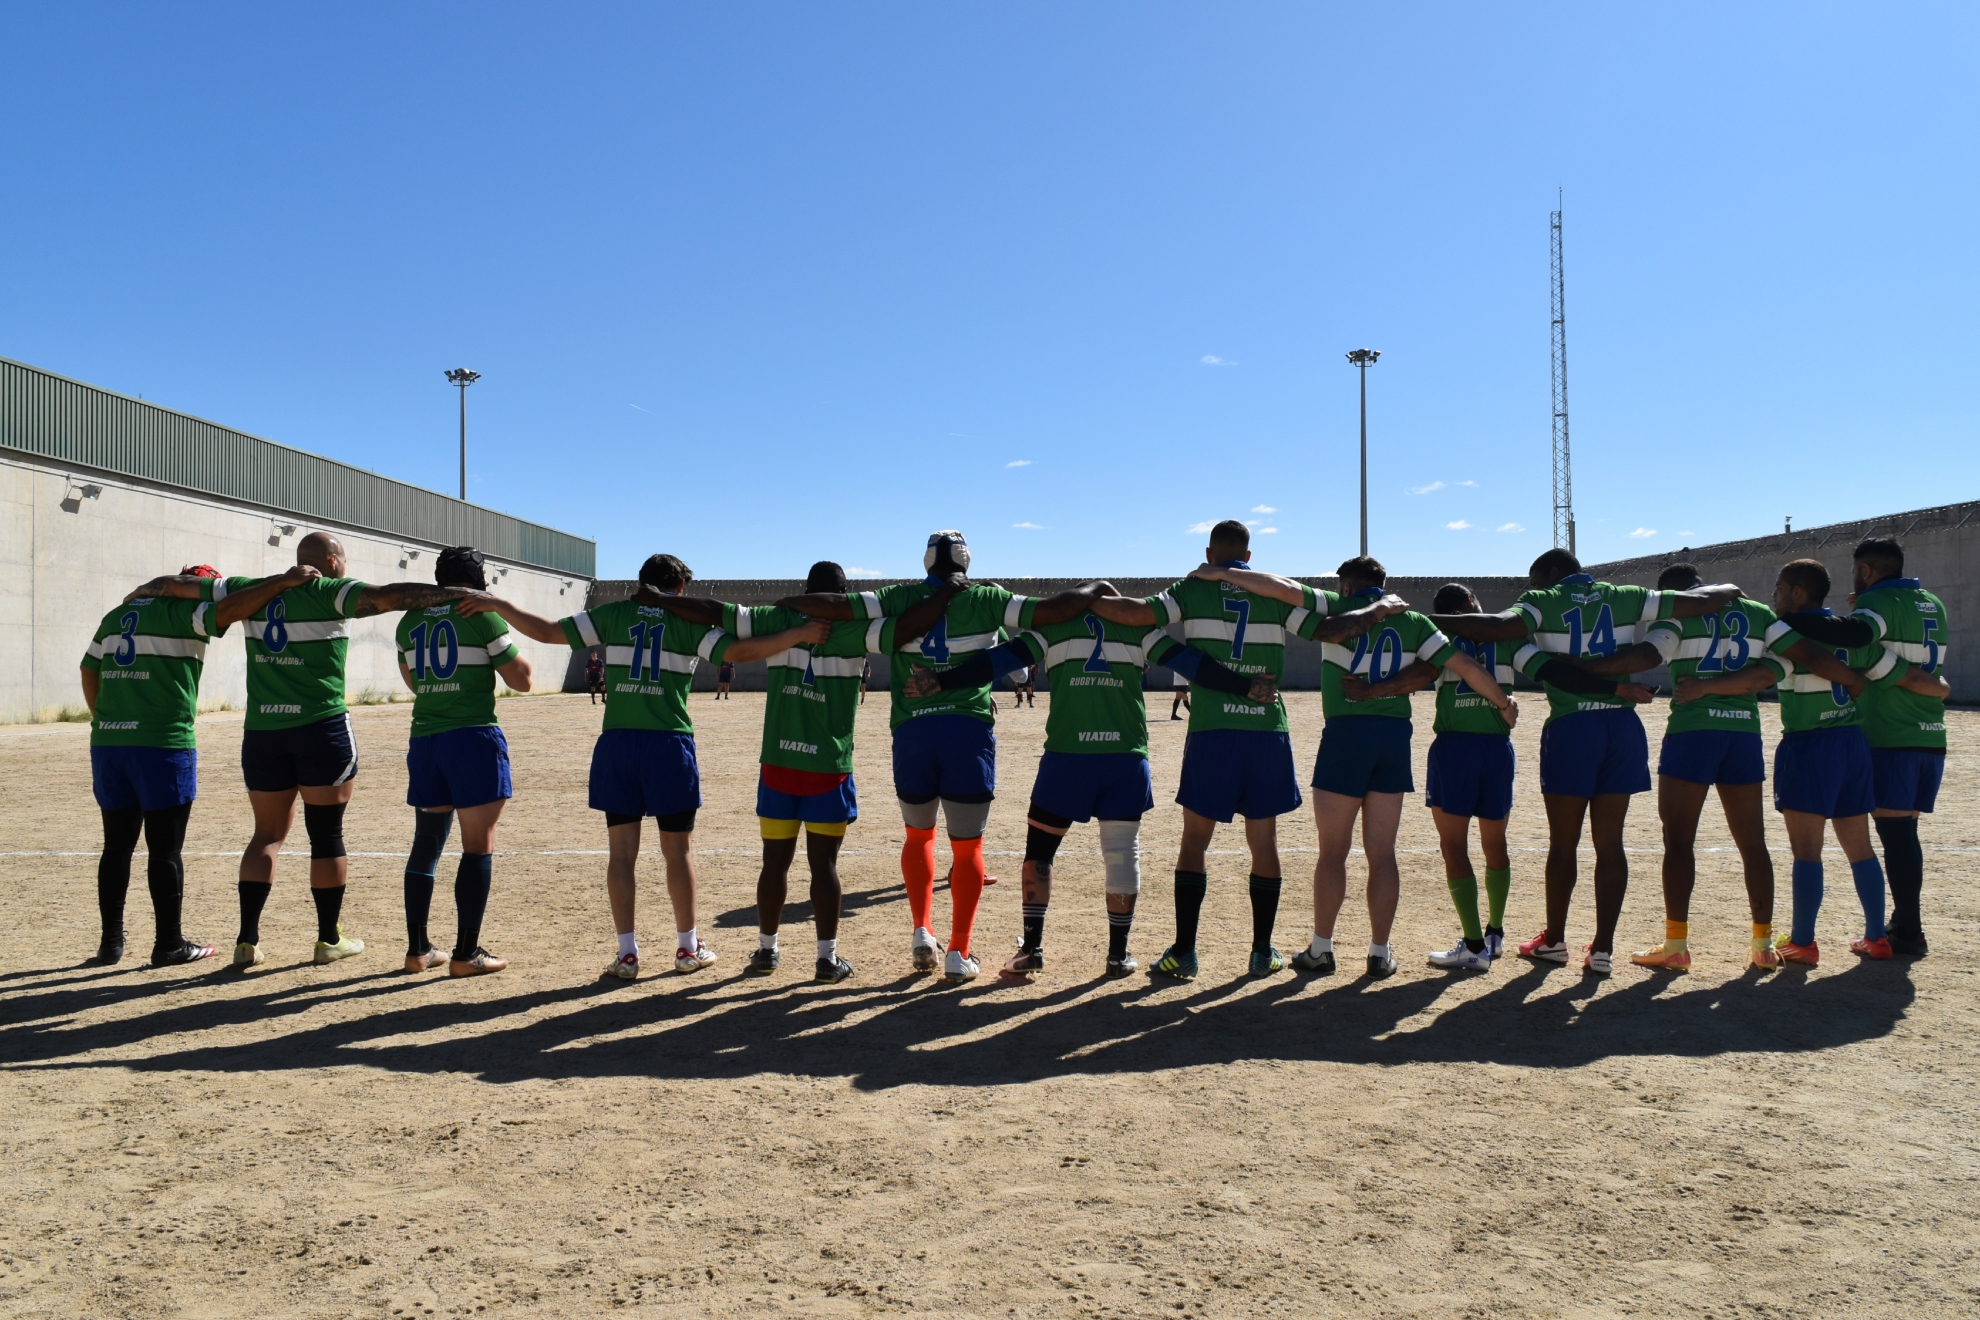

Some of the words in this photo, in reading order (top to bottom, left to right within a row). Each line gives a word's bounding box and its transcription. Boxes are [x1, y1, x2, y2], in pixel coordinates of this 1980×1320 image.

[263, 596, 288, 653] 8
[1223, 597, 1250, 661] 7
[1561, 603, 1618, 658] 14
[113, 611, 139, 667] 3
[920, 614, 951, 665] 4
[1083, 613, 1111, 675] 2
[1696, 610, 1750, 673] 23
[1920, 617, 1938, 674] 5
[409, 618, 459, 681] 10
[628, 620, 665, 682] 11
[121, 670, 150, 680] MADIBA
[1069, 676, 1096, 687] RUGBY
[432, 683, 460, 693] MADIBA
[615, 683, 639, 693] RUGBY
[260, 704, 302, 714] VIATOR
[1223, 703, 1266, 716] VIATOR
[1454, 697, 1480, 708] RUGBY
[1708, 708, 1752, 720] VIATOR
[99, 721, 139, 730] VIATOR
[1078, 731, 1121, 742] VIATOR
[779, 739, 818, 754] VIATOR
